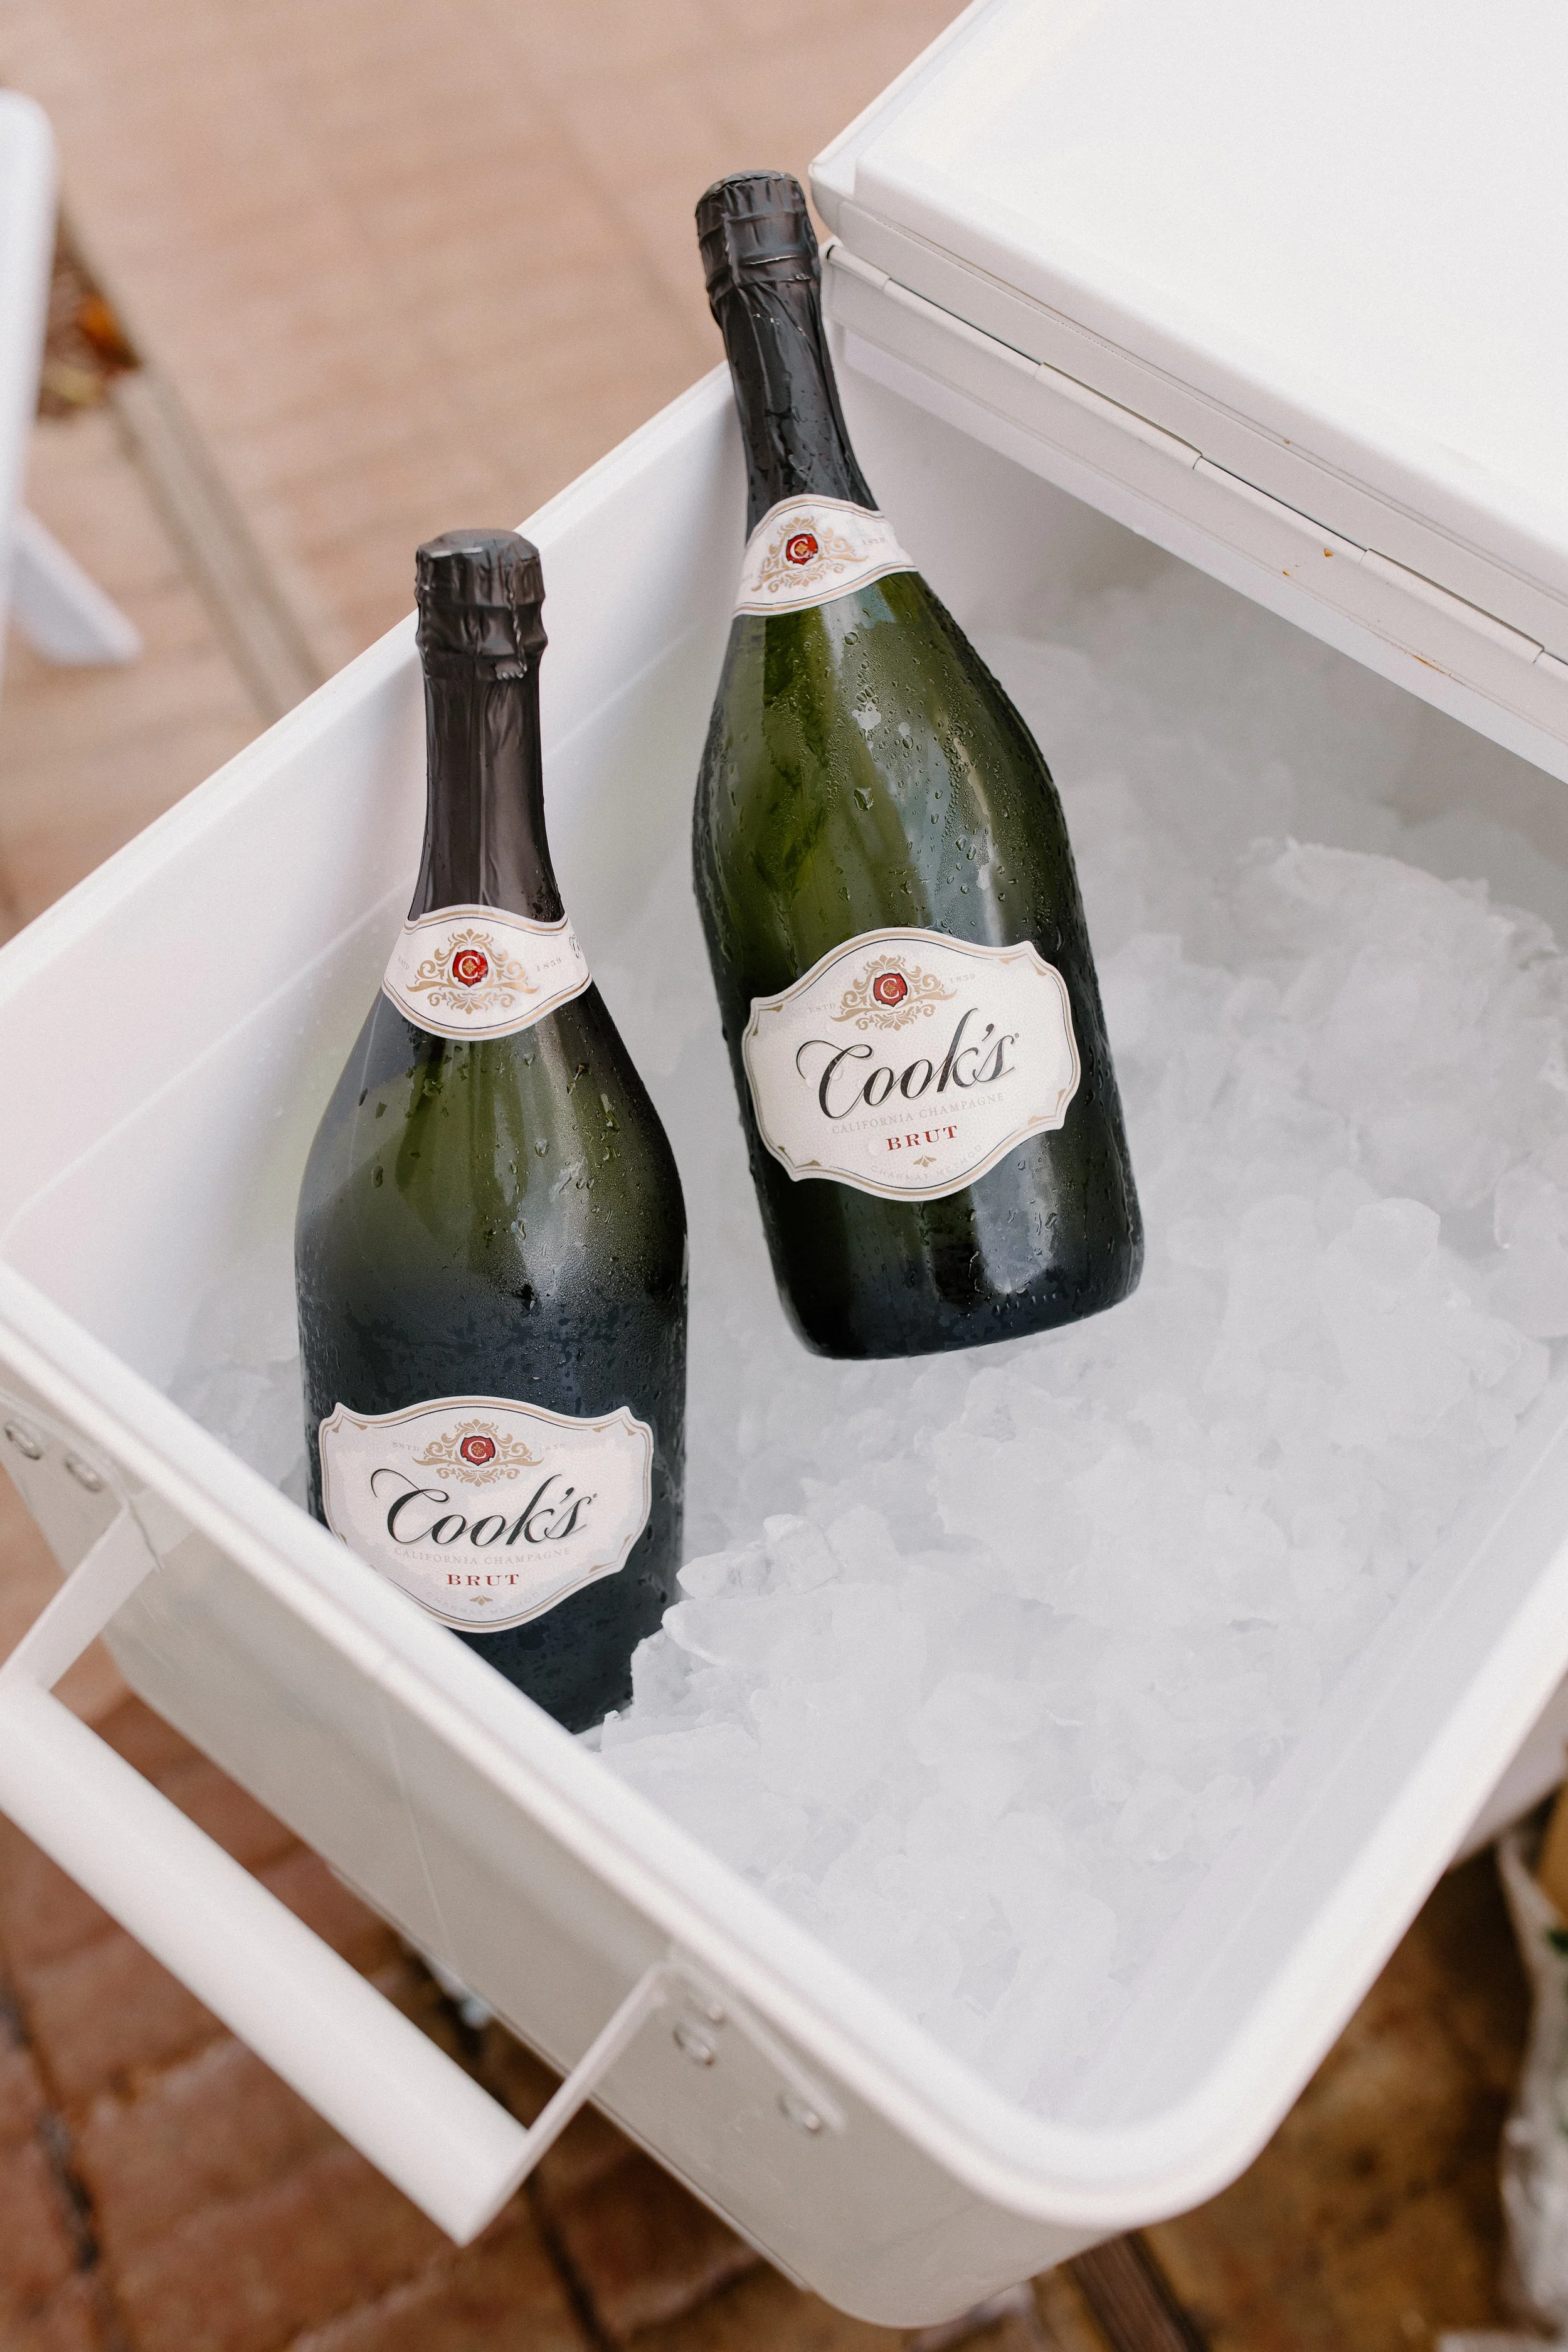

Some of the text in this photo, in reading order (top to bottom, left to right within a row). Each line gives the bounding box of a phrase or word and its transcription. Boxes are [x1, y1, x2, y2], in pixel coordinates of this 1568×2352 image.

[880, 977, 899, 999] C
[949, 973, 976, 983] 1859
[831, 1092, 1005, 1135] CALIFORNIA CHAMPAGNE
[885, 1125, 958, 1152] BRUT
[870, 1143, 983, 1182] CHARMAT METHOD
[467, 1440, 487, 1459] C
[395, 1547, 572, 1565] CALIFORNIA CHAMPAGNE
[446, 1573, 520, 1587] BRUT
